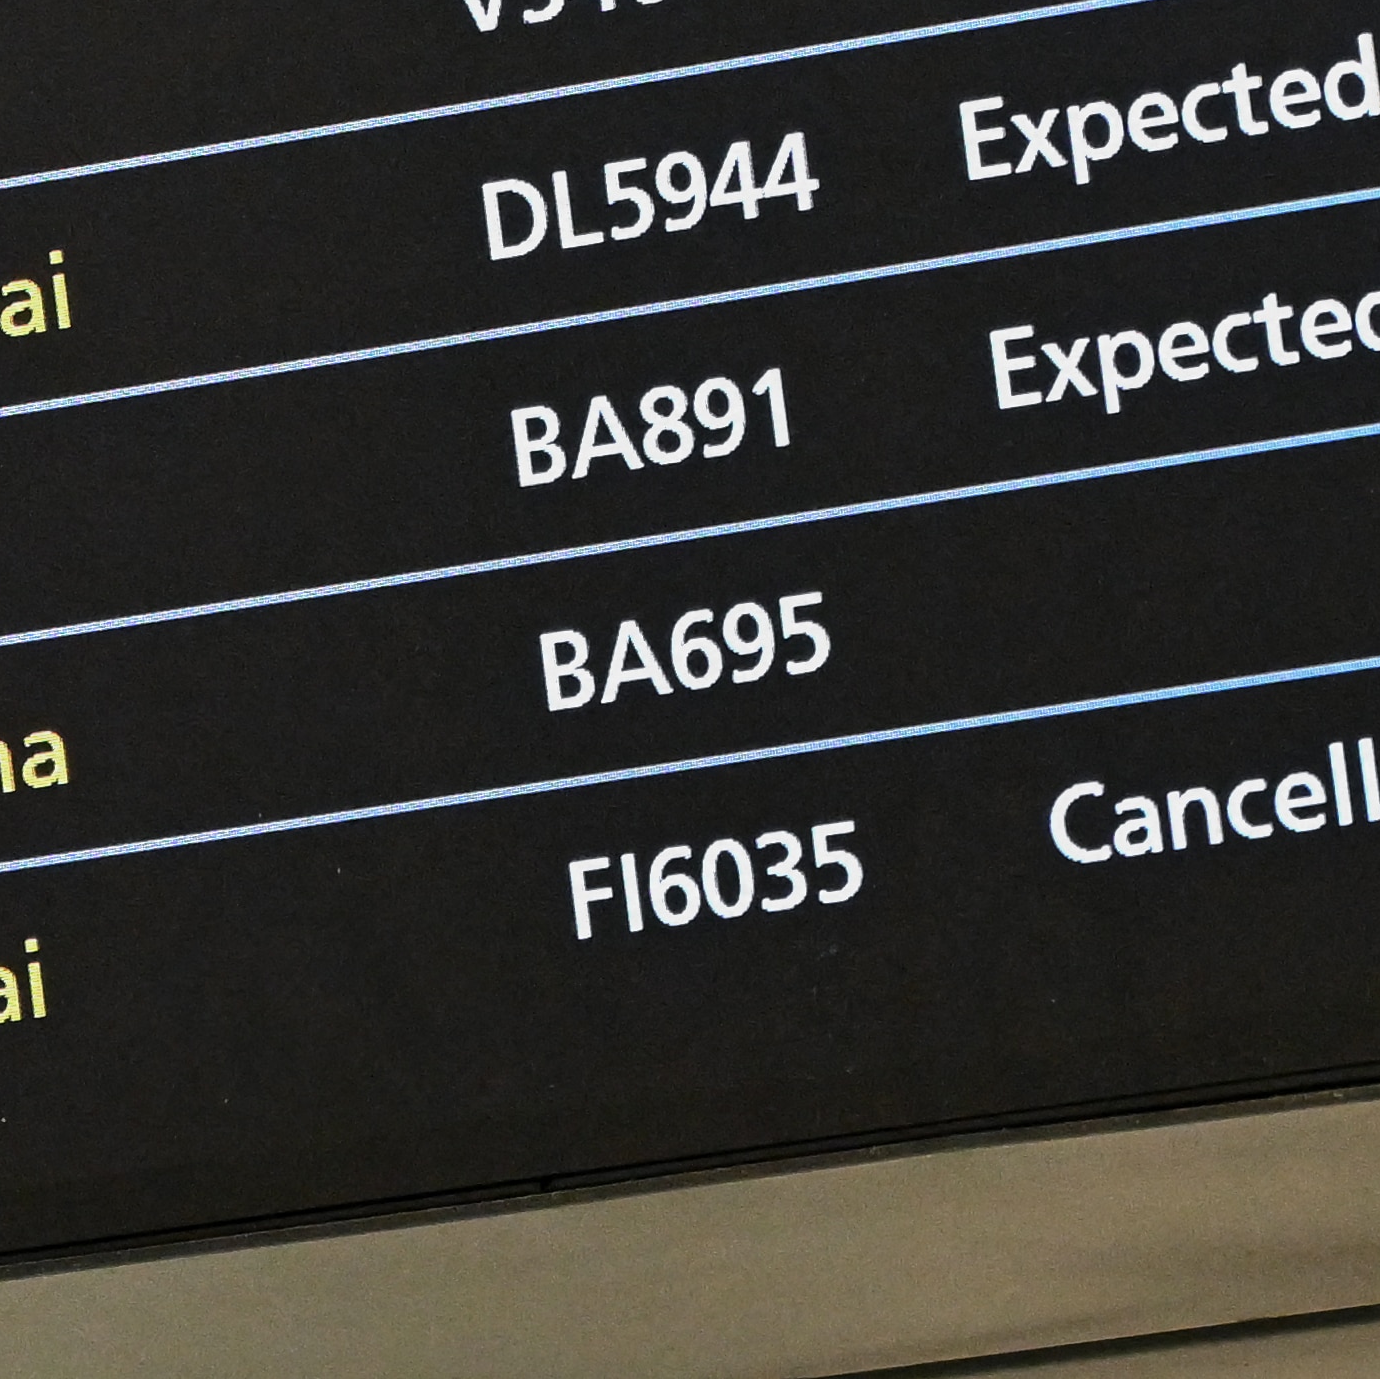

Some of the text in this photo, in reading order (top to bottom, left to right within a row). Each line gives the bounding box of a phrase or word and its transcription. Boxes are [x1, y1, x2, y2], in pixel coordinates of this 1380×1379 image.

[482, 132, 819, 260] DL5944
[511, 368, 790, 487] BA891
[540, 592, 830, 711] BA695
[569, 821, 863, 939] FI6035
